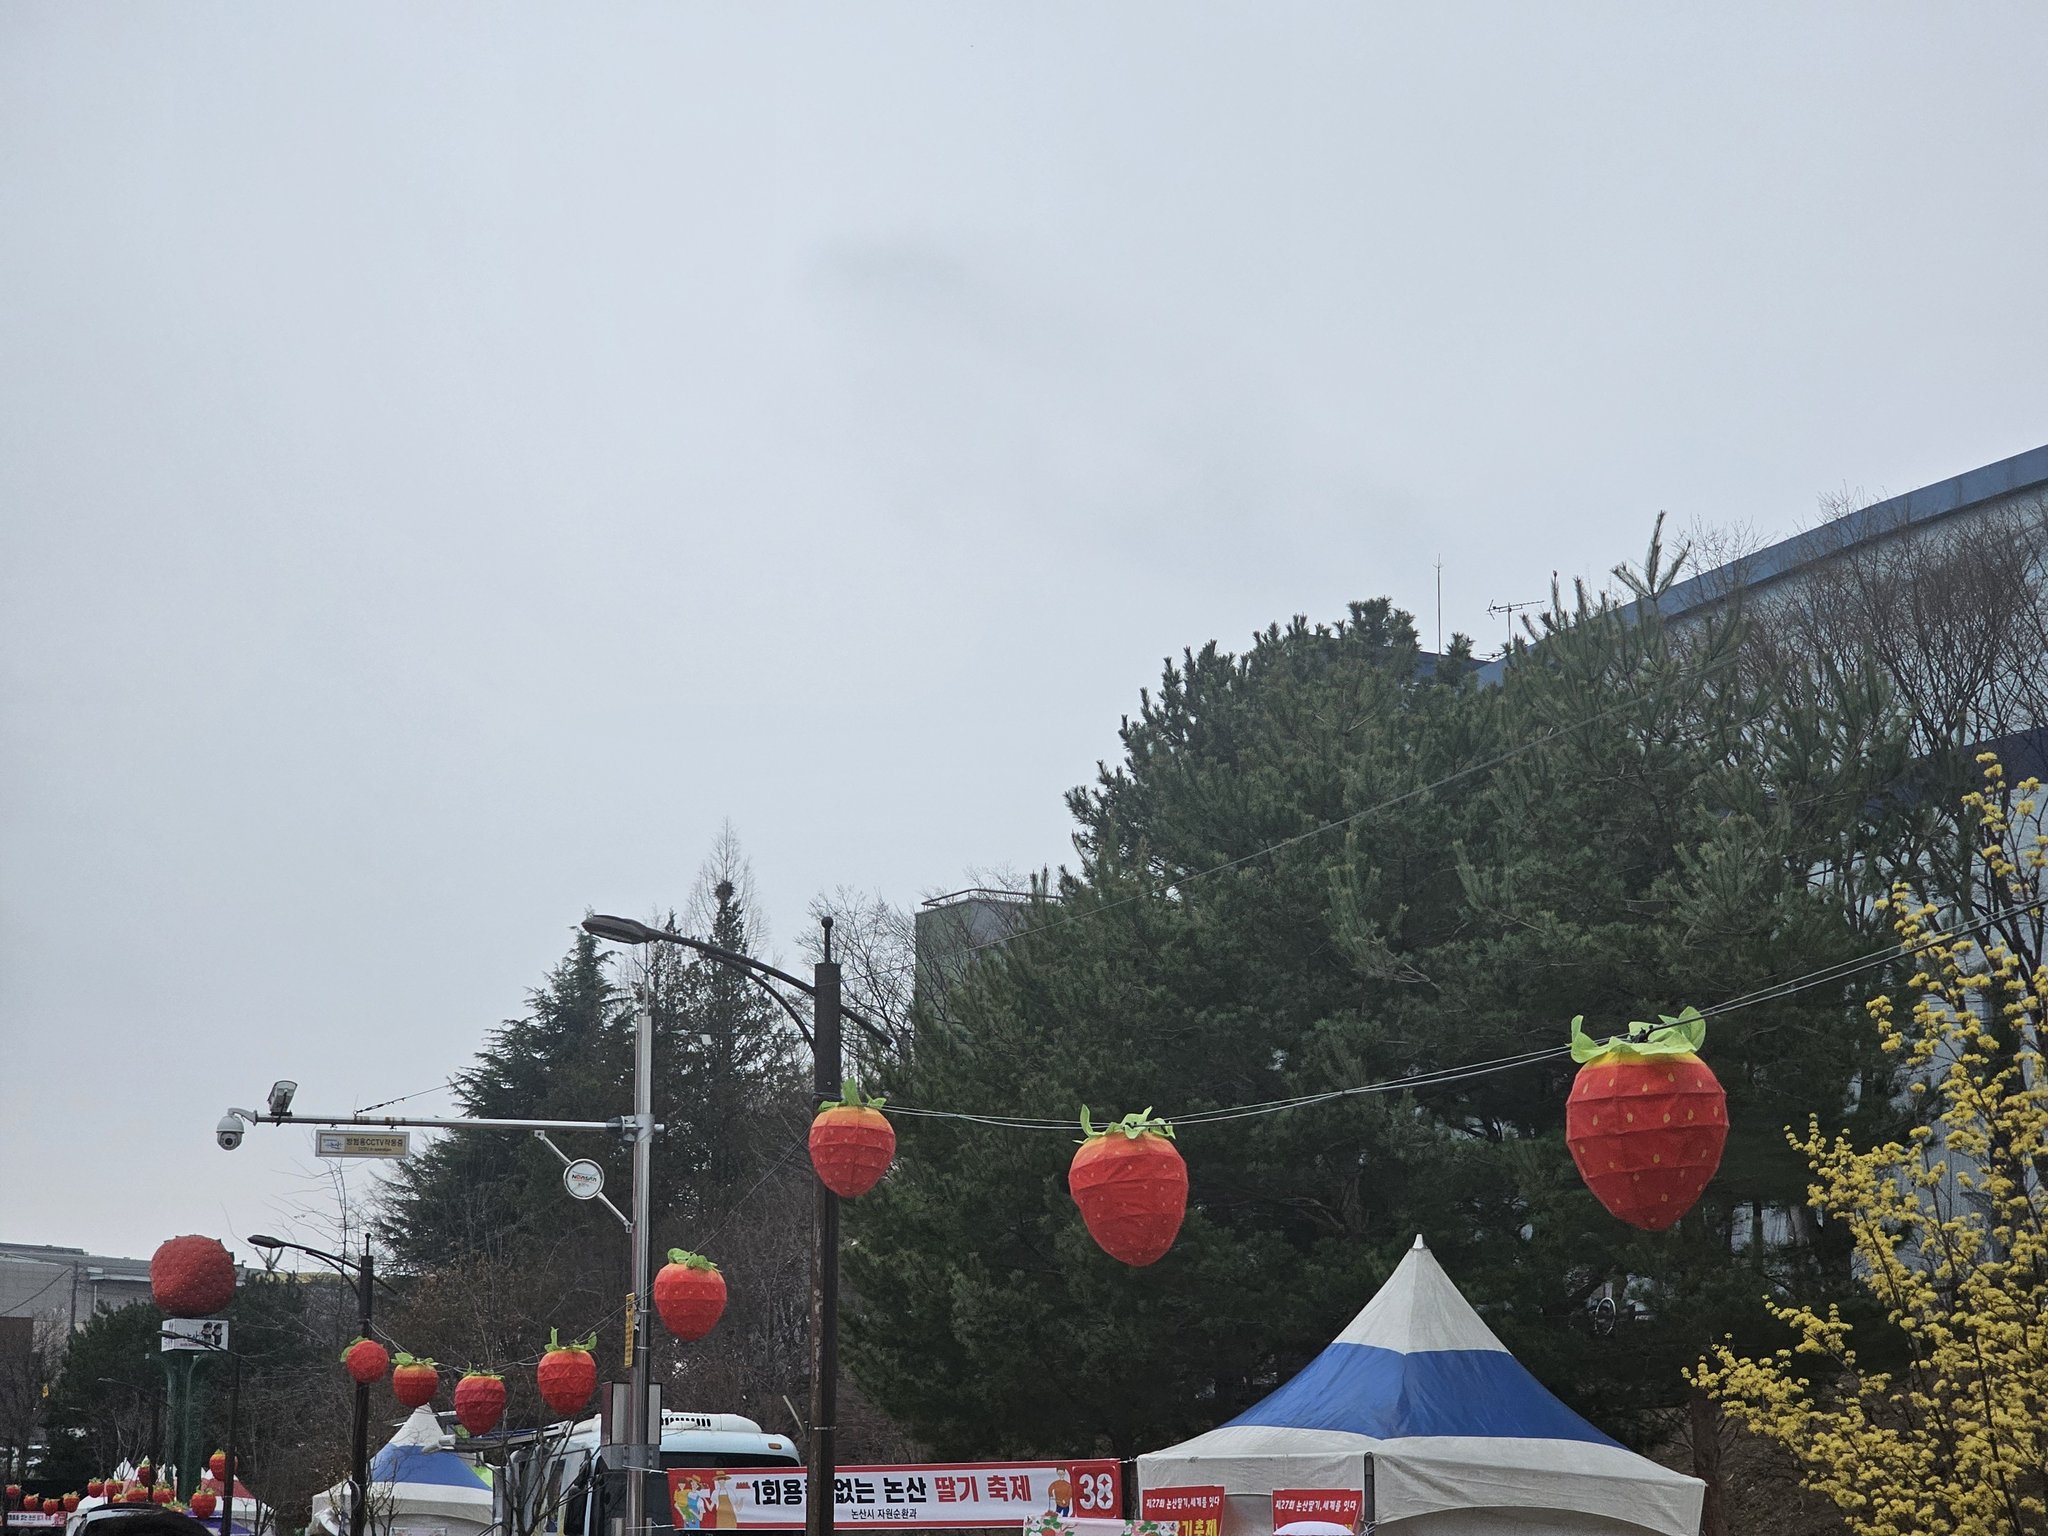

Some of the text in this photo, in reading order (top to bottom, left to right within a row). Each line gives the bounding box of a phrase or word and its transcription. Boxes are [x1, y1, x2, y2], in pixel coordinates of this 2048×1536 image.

[752, 1475, 1032, 1505] 1회용 없는 논산 딸기 축제
[1079, 1473, 1114, 1510] 38
[1146, 1498, 1165, 1509] 제27회
[1275, 1499, 1295, 1510] 제27회
[851, 1508, 917, 1519] 논산시 자원순환과
